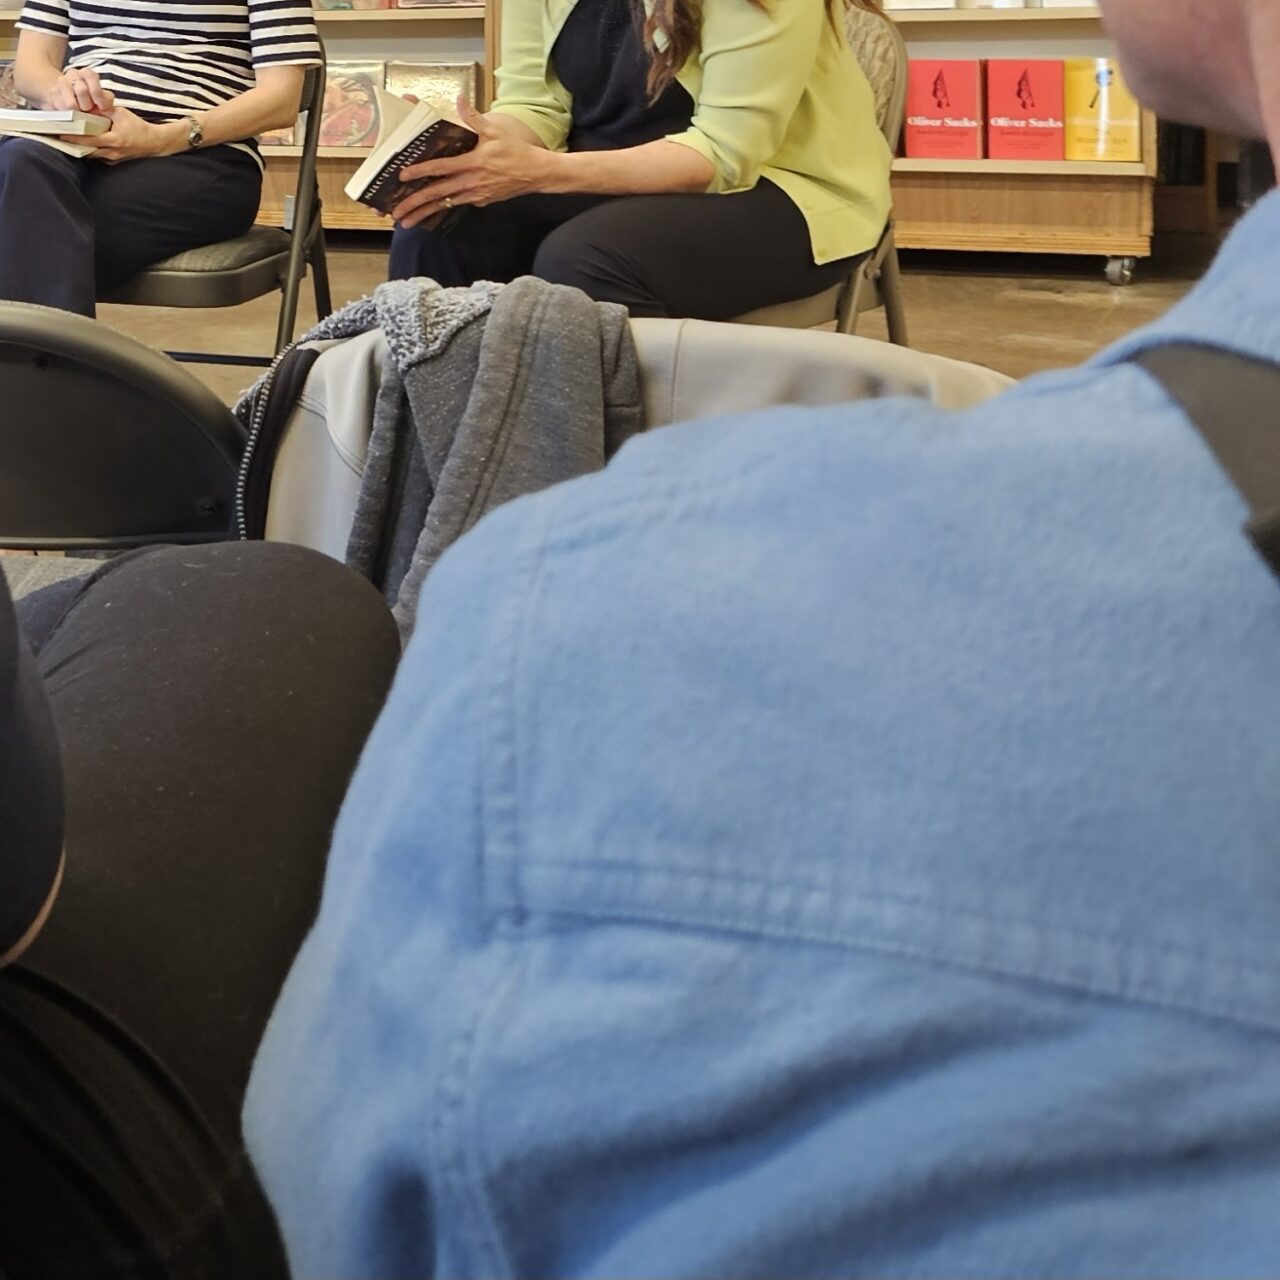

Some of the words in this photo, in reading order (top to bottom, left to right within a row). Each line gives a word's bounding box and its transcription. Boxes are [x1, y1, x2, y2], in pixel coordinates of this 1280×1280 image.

[907, 116, 942, 127] Oliver
[943, 117, 979, 128] Sacks
[990, 116, 1027, 127] Oliver
[1028, 117, 1064, 128] Sacks
